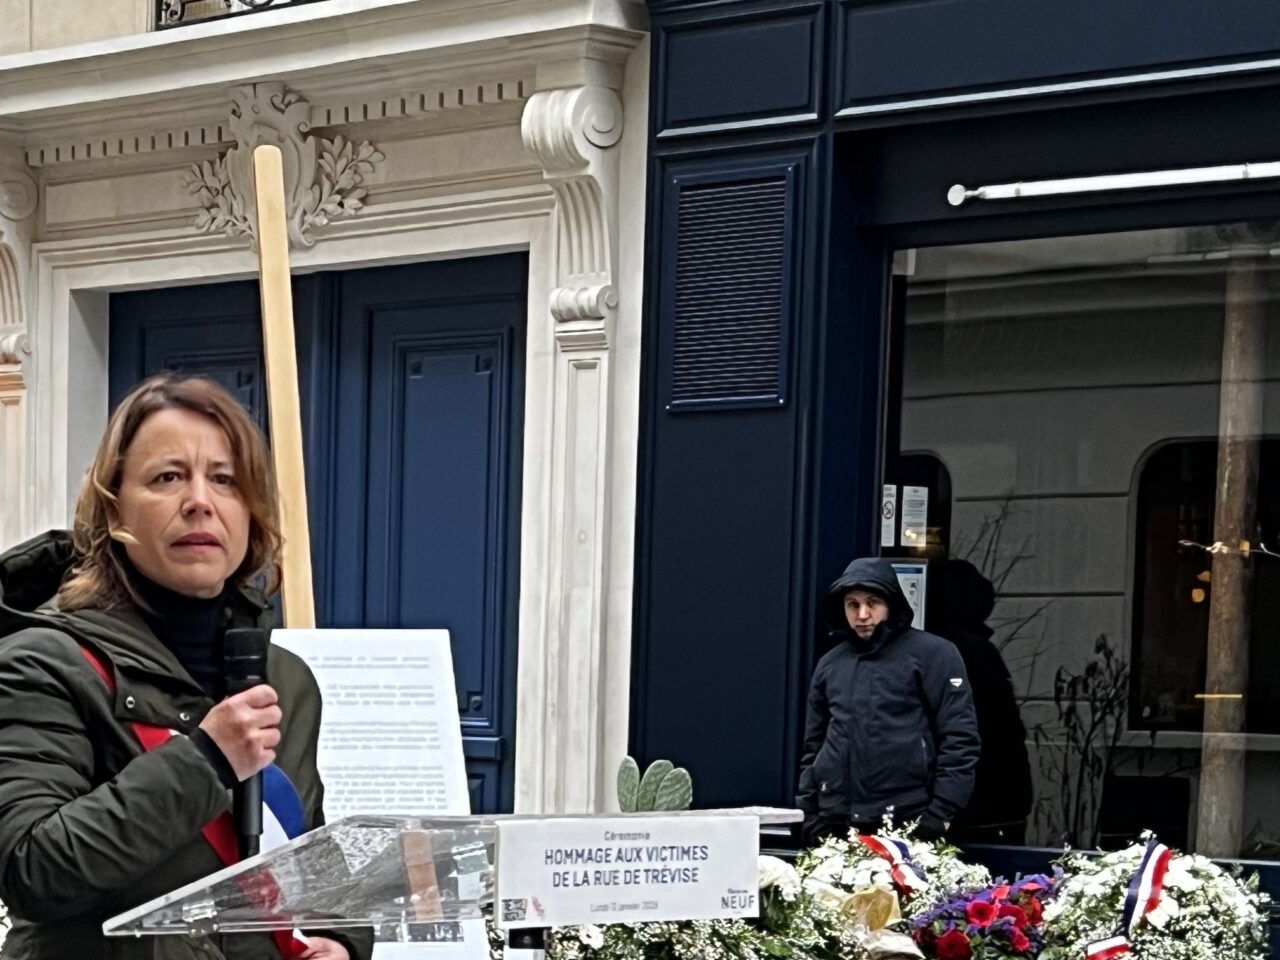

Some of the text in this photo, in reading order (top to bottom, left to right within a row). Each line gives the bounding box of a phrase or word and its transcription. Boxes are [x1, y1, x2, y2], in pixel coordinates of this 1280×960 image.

[545, 845, 709, 865] HOMMAGE AUX VICTIMES
[553, 864, 699, 887] DE LA RUE DE TRÉVISE
[721, 895, 755, 909] NEUF
